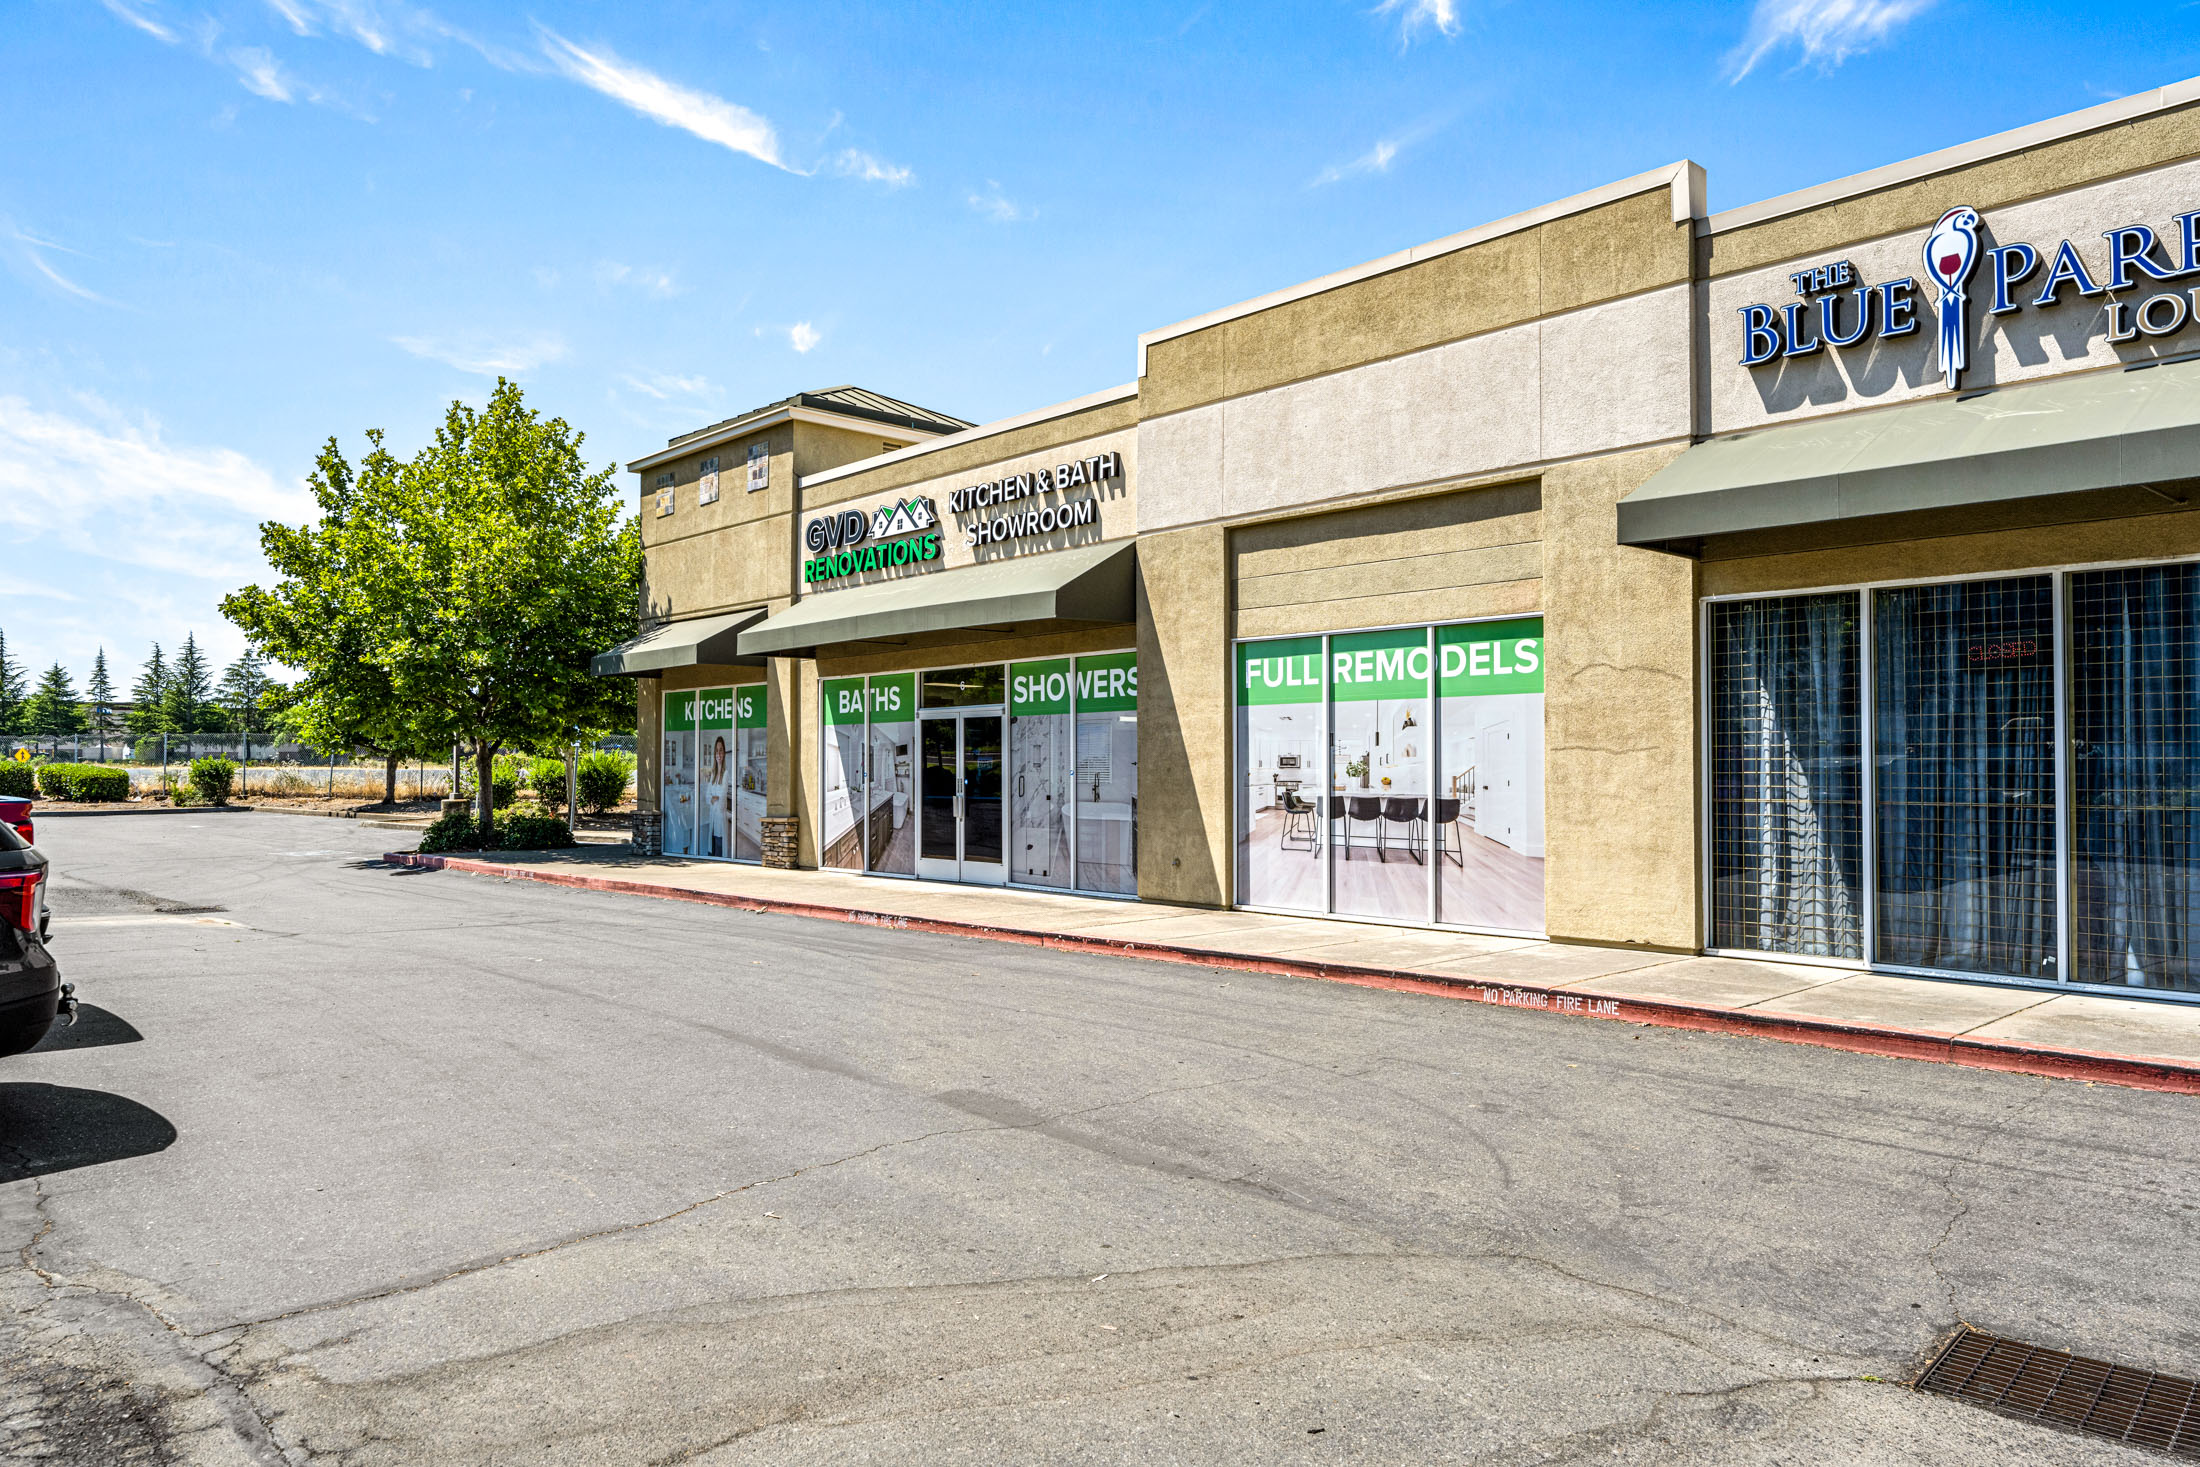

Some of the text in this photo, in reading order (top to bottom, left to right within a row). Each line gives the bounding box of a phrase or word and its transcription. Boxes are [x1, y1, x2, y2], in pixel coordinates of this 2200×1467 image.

[1790, 260, 1850, 296] THE
[1738, 276, 1918, 367] BLUE
[2103, 285, 2200, 343] LO
[949, 451, 1117, 514] KITCHEN & BATH
[806, 509, 866, 553] GVD
[966, 498, 1093, 547] SHOWROOM
[805, 534, 937, 583] RENOVATIONS
[1246, 639, 1539, 688] FULL REMODELS
[1968, 640, 2037, 661] CLOSED
[839, 686, 901, 714] BATHS
[960, 680, 966, 691] 6
[1483, 988, 1619, 1015] NO PARKING FIRE LANE
